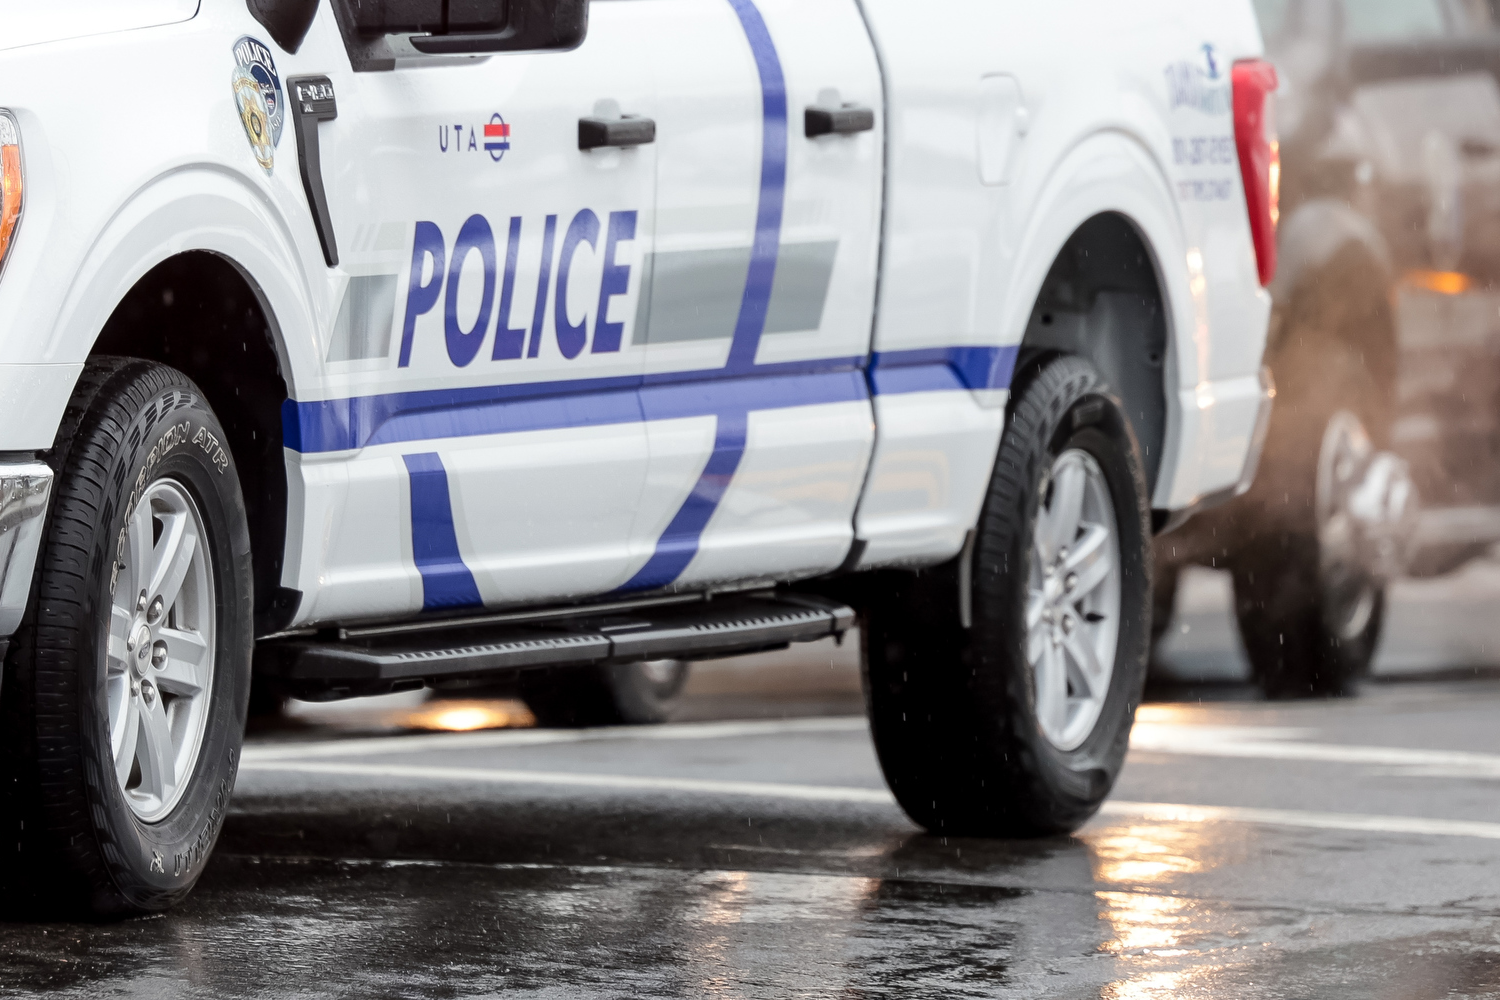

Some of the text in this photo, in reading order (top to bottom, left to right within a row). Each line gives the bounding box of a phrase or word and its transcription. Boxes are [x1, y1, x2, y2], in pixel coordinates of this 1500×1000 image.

[235, 41, 277, 77] POLICE
[439, 124, 478, 153] UTA
[397, 207, 639, 369] POLICE
[192, 426, 229, 475] ATR
